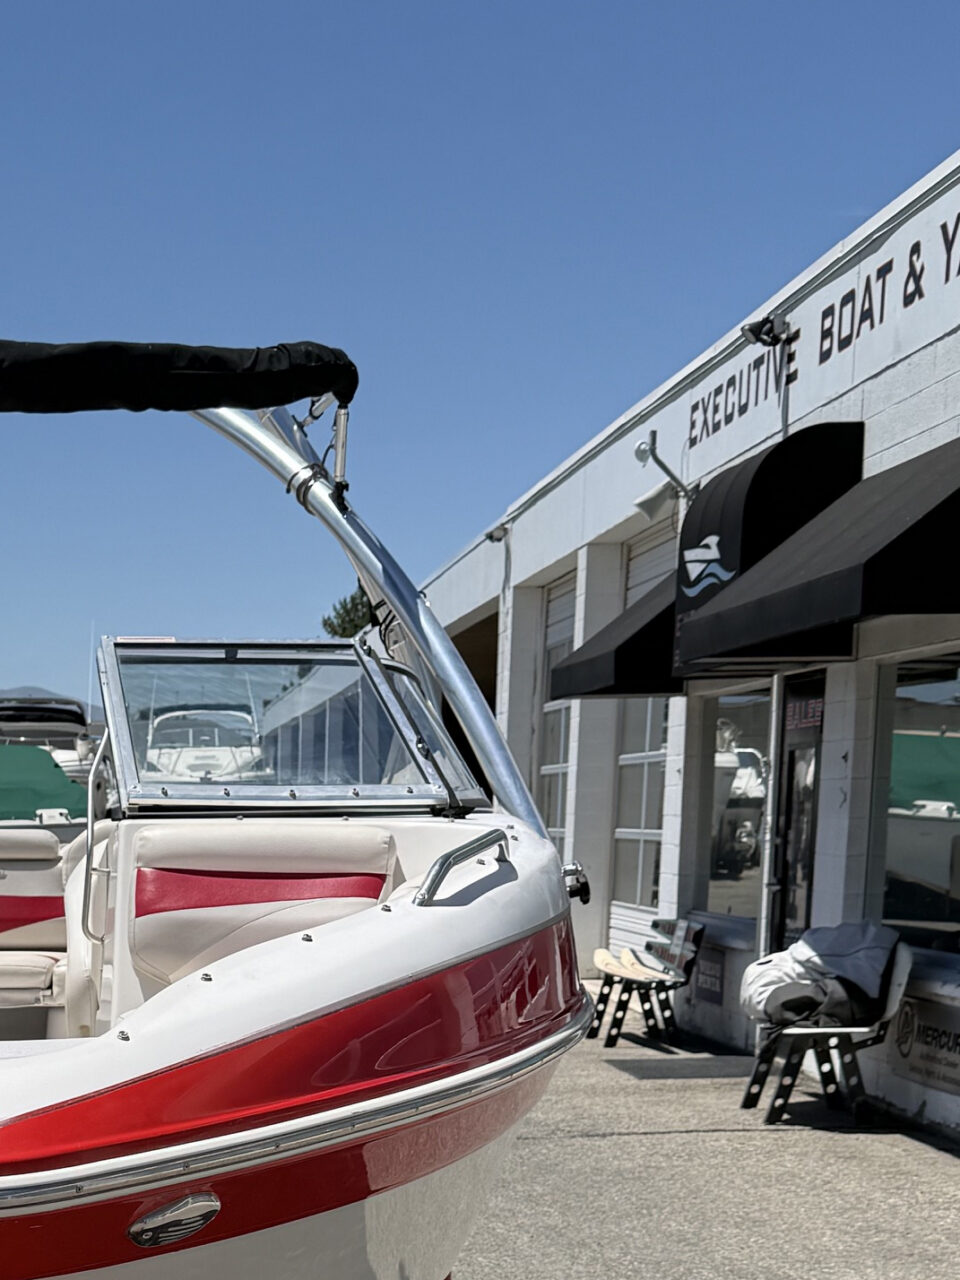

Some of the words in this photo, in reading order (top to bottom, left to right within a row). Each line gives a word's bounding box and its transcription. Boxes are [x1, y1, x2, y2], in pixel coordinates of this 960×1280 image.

[689, 328, 800, 450] EXECUTIVE
[819, 258, 894, 366] BOAT
[903, 240, 925, 309] &
[940, 211, 960, 285] Y
